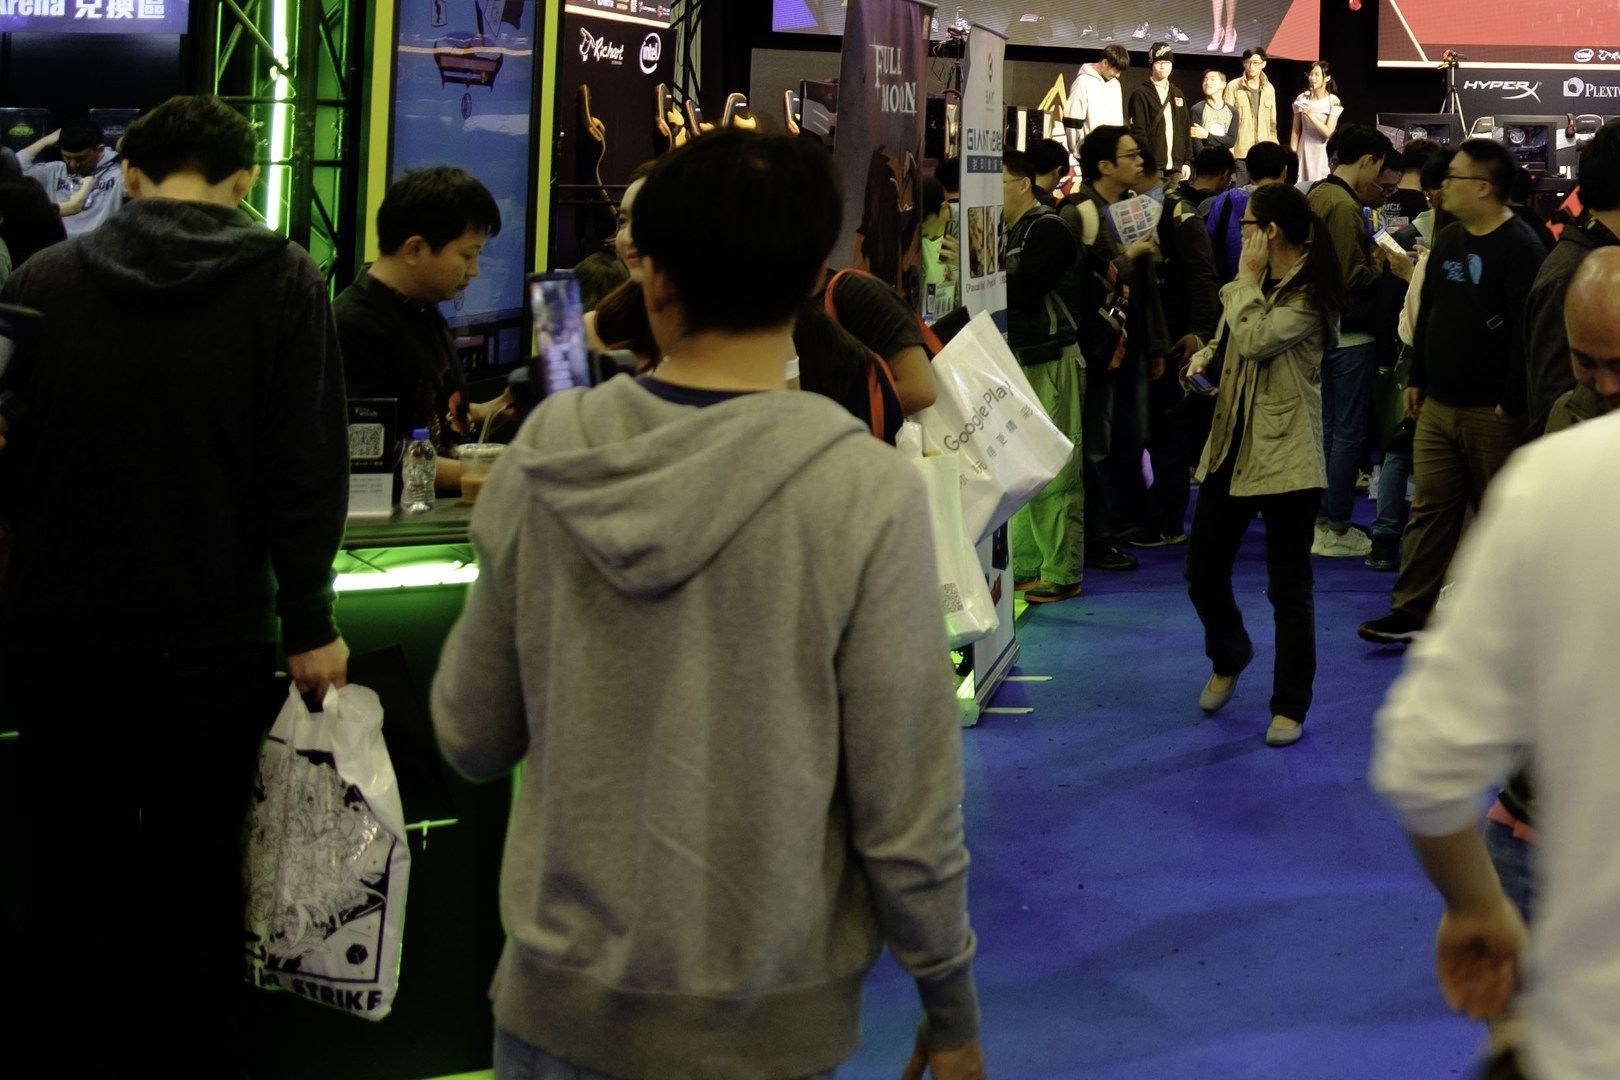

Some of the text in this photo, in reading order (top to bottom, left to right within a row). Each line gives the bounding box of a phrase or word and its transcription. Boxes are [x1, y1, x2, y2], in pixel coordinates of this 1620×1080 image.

[594, 37, 625, 61] Richart
[869, 42, 902, 88] FULL
[881, 82, 917, 115] MOON
[1463, 80, 1541, 103] HYPERX
[944, 380, 1014, 452] Google Play
